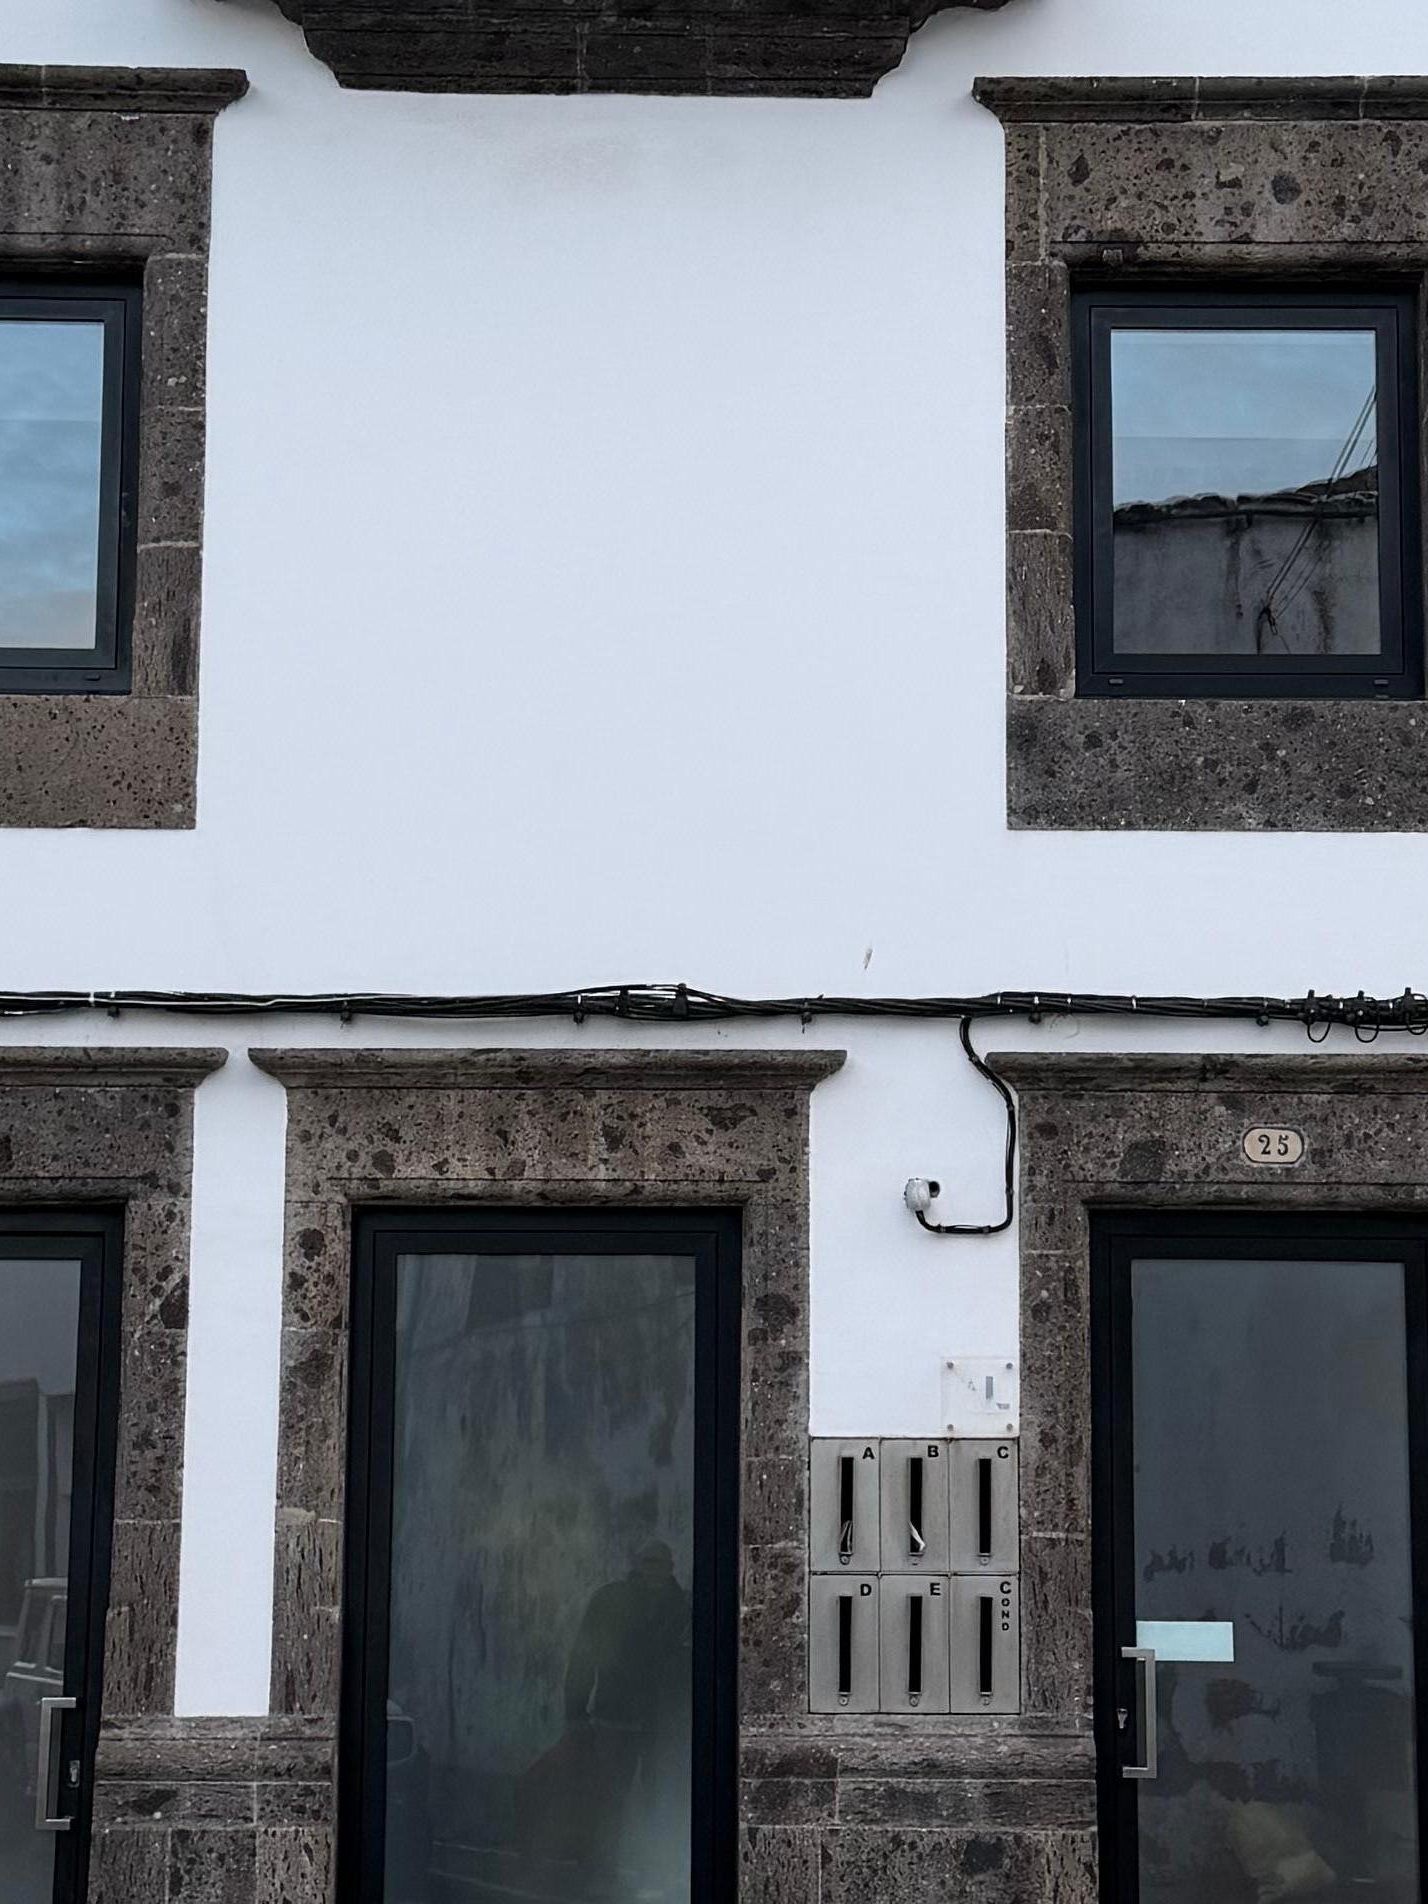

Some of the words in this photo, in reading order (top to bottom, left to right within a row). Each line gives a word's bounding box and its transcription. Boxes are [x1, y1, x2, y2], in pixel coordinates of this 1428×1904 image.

[1257, 1134, 1289, 1156] 25
[862, 1446, 875, 1460] A
[927, 1445, 940, 1458] B
[997, 1446, 1009, 1459] C
[860, 1583, 872, 1596] D
[929, 1582, 941, 1596] E
[999, 1581, 1012, 1631] COND
